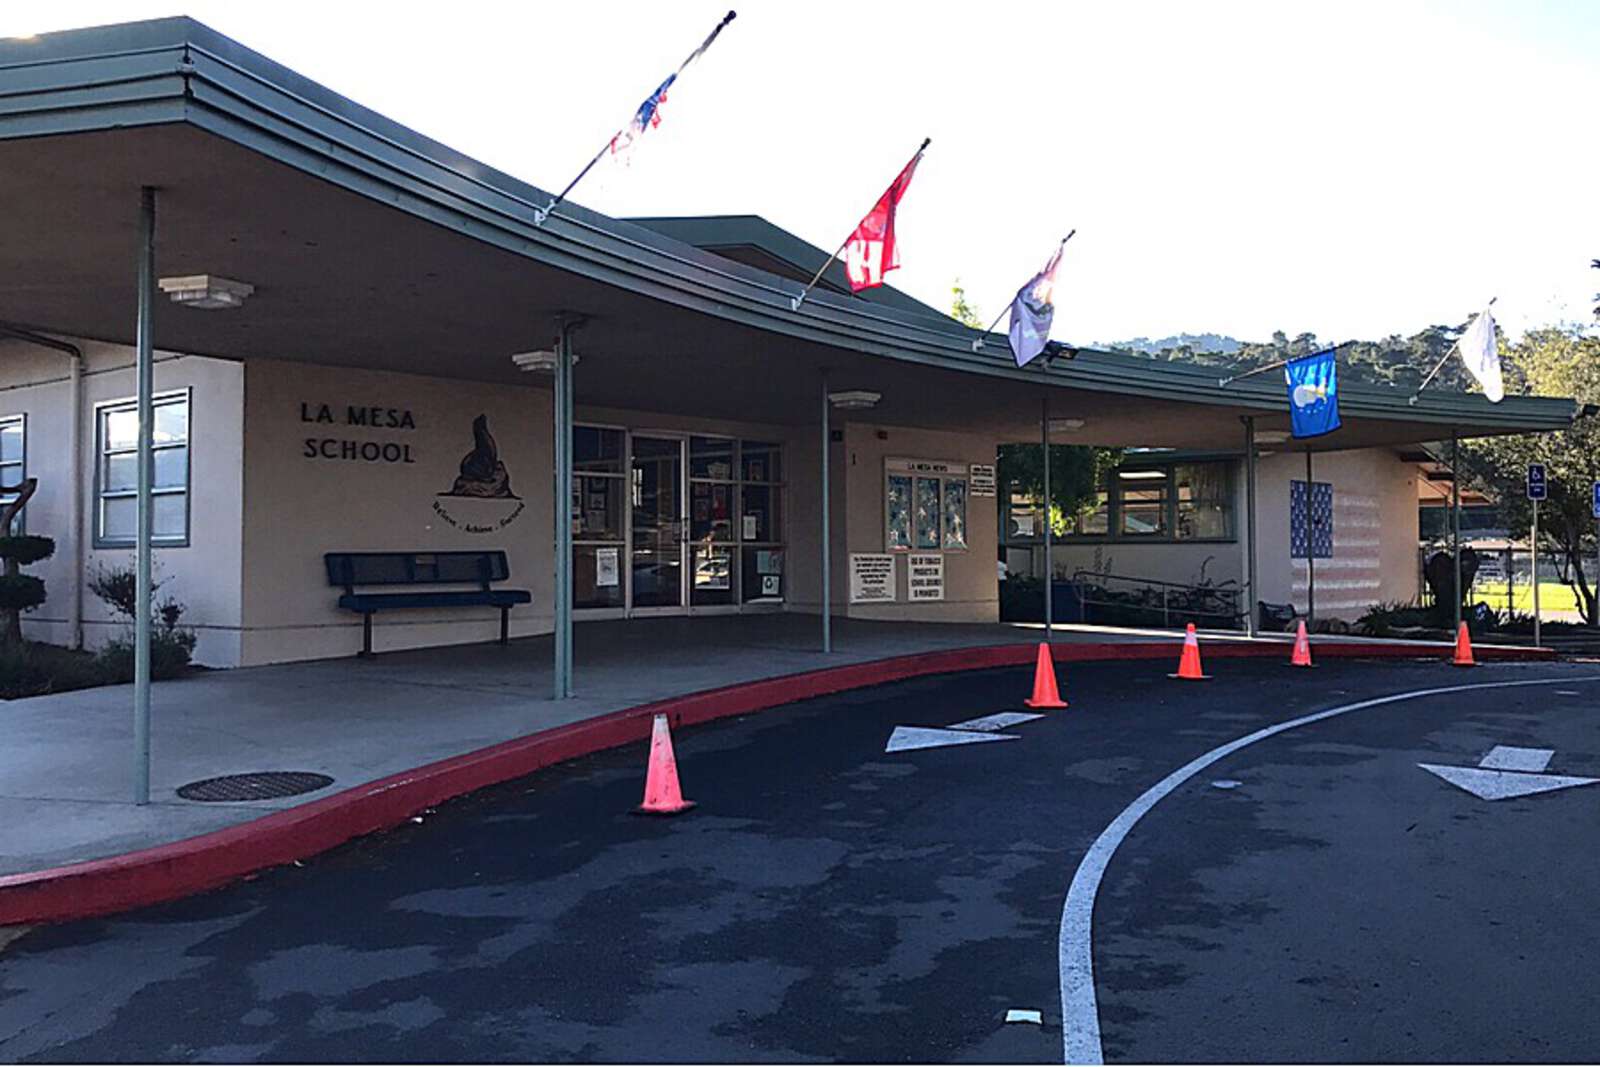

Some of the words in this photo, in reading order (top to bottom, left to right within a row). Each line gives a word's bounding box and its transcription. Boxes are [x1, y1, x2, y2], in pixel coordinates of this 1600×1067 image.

[301, 402, 334, 424] LA
[347, 405, 416, 430] MESA
[303, 438, 416, 463] SCHOOL
[917, 463, 931, 471] MESA
[933, 464, 948, 472] NEWS
